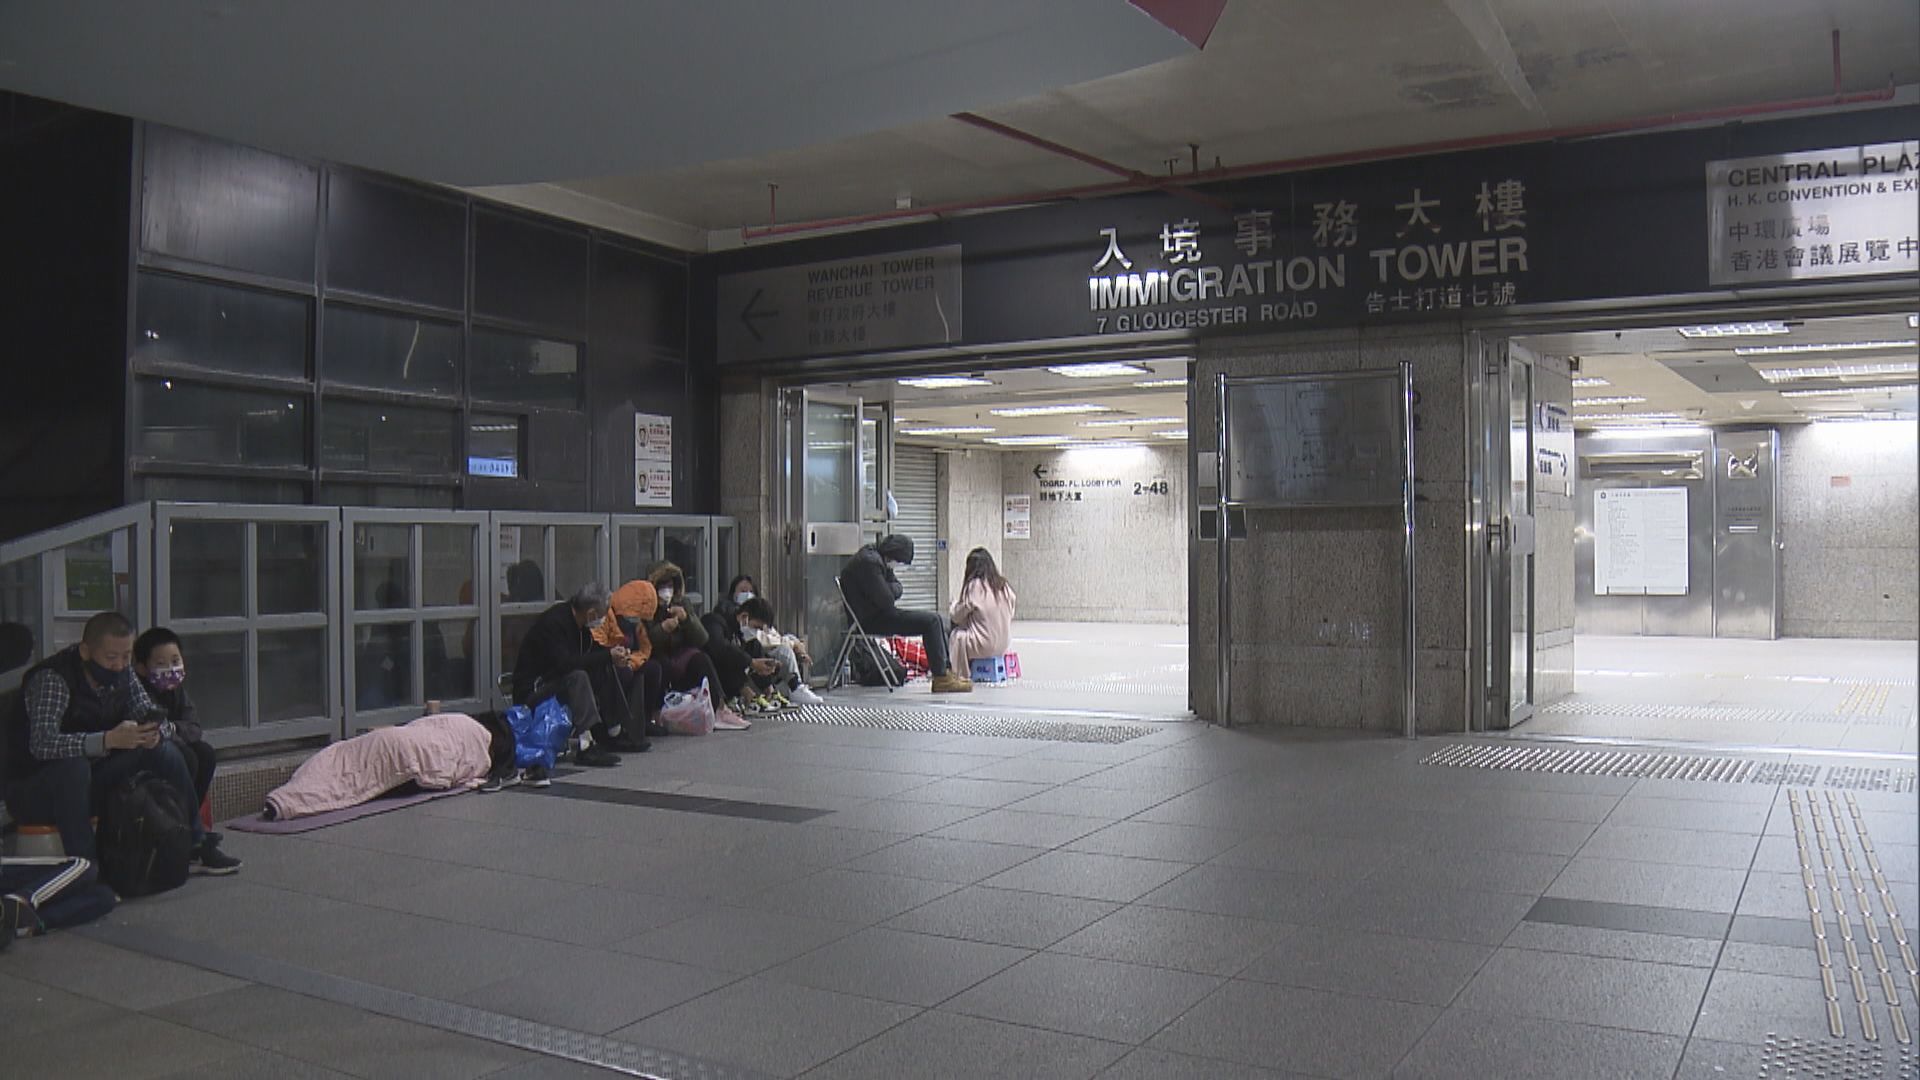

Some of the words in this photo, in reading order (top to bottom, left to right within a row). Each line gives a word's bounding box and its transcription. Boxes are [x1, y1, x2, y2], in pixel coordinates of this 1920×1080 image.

[1728, 161, 1846, 187] CENTRAL
[1728, 194, 1743, 207] H.
[1748, 191, 1762, 206] K.
[1767, 182, 1872, 204] CONVENTION
[1876, 181, 1887, 193] &
[1093, 178, 1526, 272] 入境事務大樓
[1729, 214, 1831, 243] 中環廣場
[807, 263, 873, 284] WANCHAI
[881, 256, 935, 275] TOWER
[1089, 252, 1346, 312] IMMIGRATION
[1369, 237, 1528, 283] TOWER
[807, 281, 873, 304] REVENUE
[881, 276, 935, 294] TOWER
[1366, 281, 1517, 314] 告士打道七號
[1097, 317, 1108, 334] 7
[1117, 306, 1248, 332] GLOUCESTER
[1261, 300, 1318, 322] ROAD
